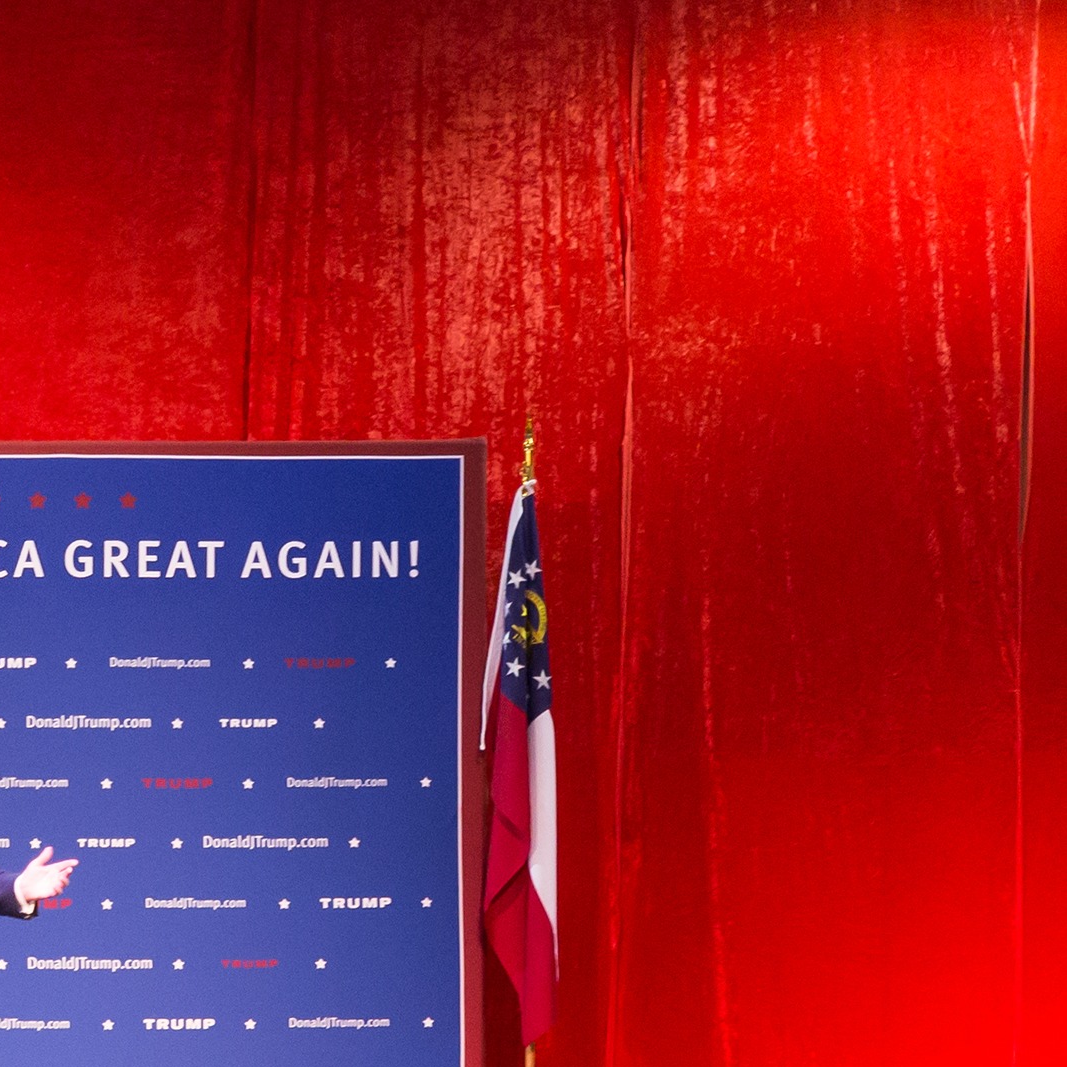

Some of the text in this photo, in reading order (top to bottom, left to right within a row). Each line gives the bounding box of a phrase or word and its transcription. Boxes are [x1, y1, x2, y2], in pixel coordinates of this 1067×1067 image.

[64, 539, 226, 579] GREAT
[240, 539, 420, 578] AGAIN!
[108, 657, 211, 671] DonaldJTrump.com
[284, 657, 356, 670] TRUMP
[26, 715, 153, 732] DonaldJTrump.com
[219, 718, 279, 729] TRUMP
[141, 777, 214, 790] TRUMP
[286, 777, 389, 790] DonaldJTrump.com
[77, 835, 330, 852] TRUMP DonaldJTrump.com
[144, 896, 393, 911] DonaldJTrump.com TRUMP
[27, 956, 280, 973] DonaldJTrump.com TRUMP
[143, 1018, 217, 1031] TRUMP
[288, 1016, 391, 1030] DonaldJTrump.com
